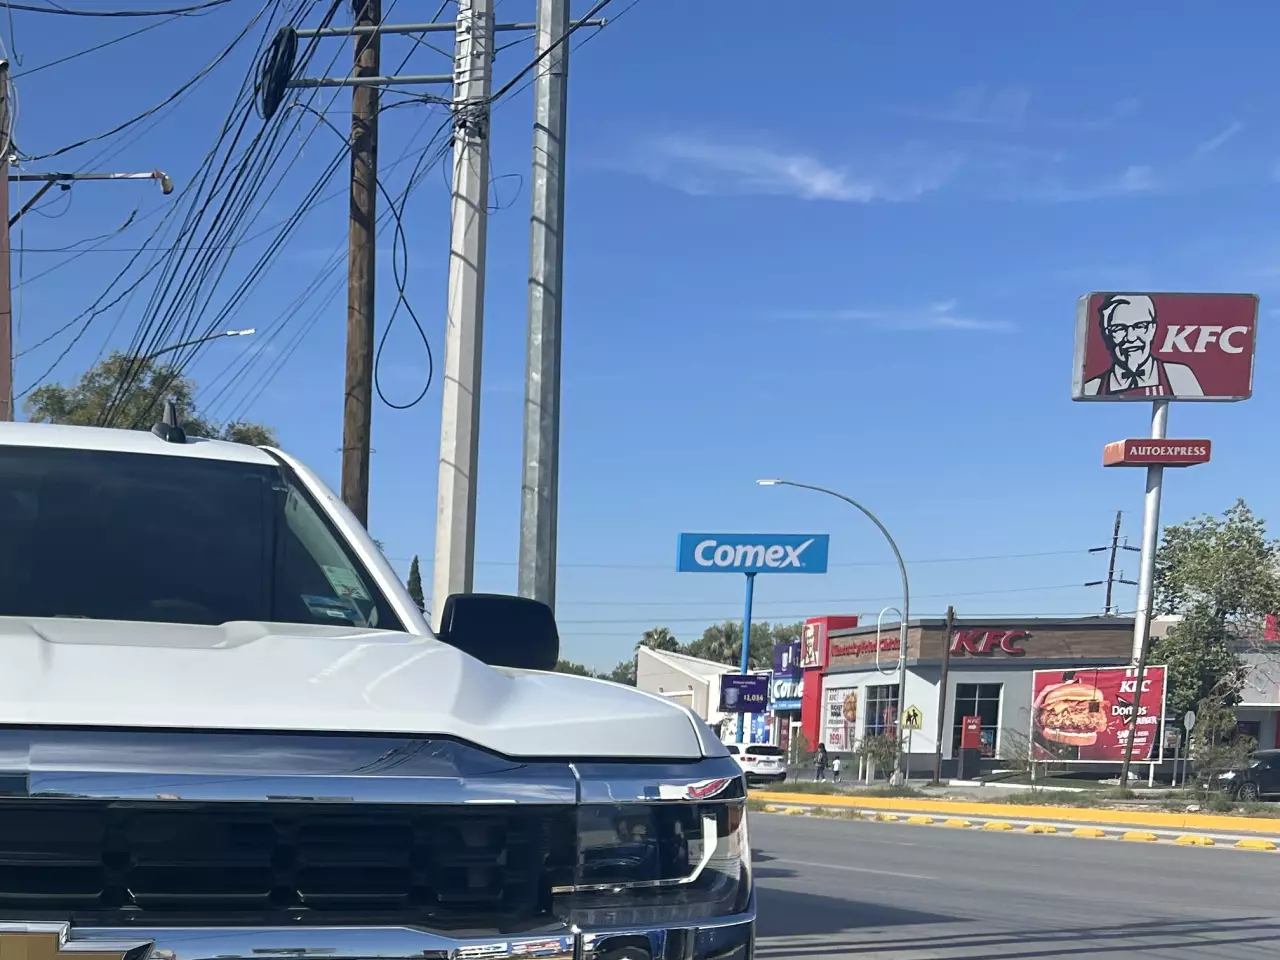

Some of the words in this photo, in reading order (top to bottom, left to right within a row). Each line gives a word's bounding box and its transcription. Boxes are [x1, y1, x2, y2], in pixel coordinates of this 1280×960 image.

[1159, 325, 1248, 353] KFC
[1130, 446, 1206, 456] AUTOEXPRESS
[694, 538, 815, 568] Comex
[950, 629, 1026, 653] KFC
[774, 679, 804, 699] Come
[1111, 705, 1147, 716] Dorios
